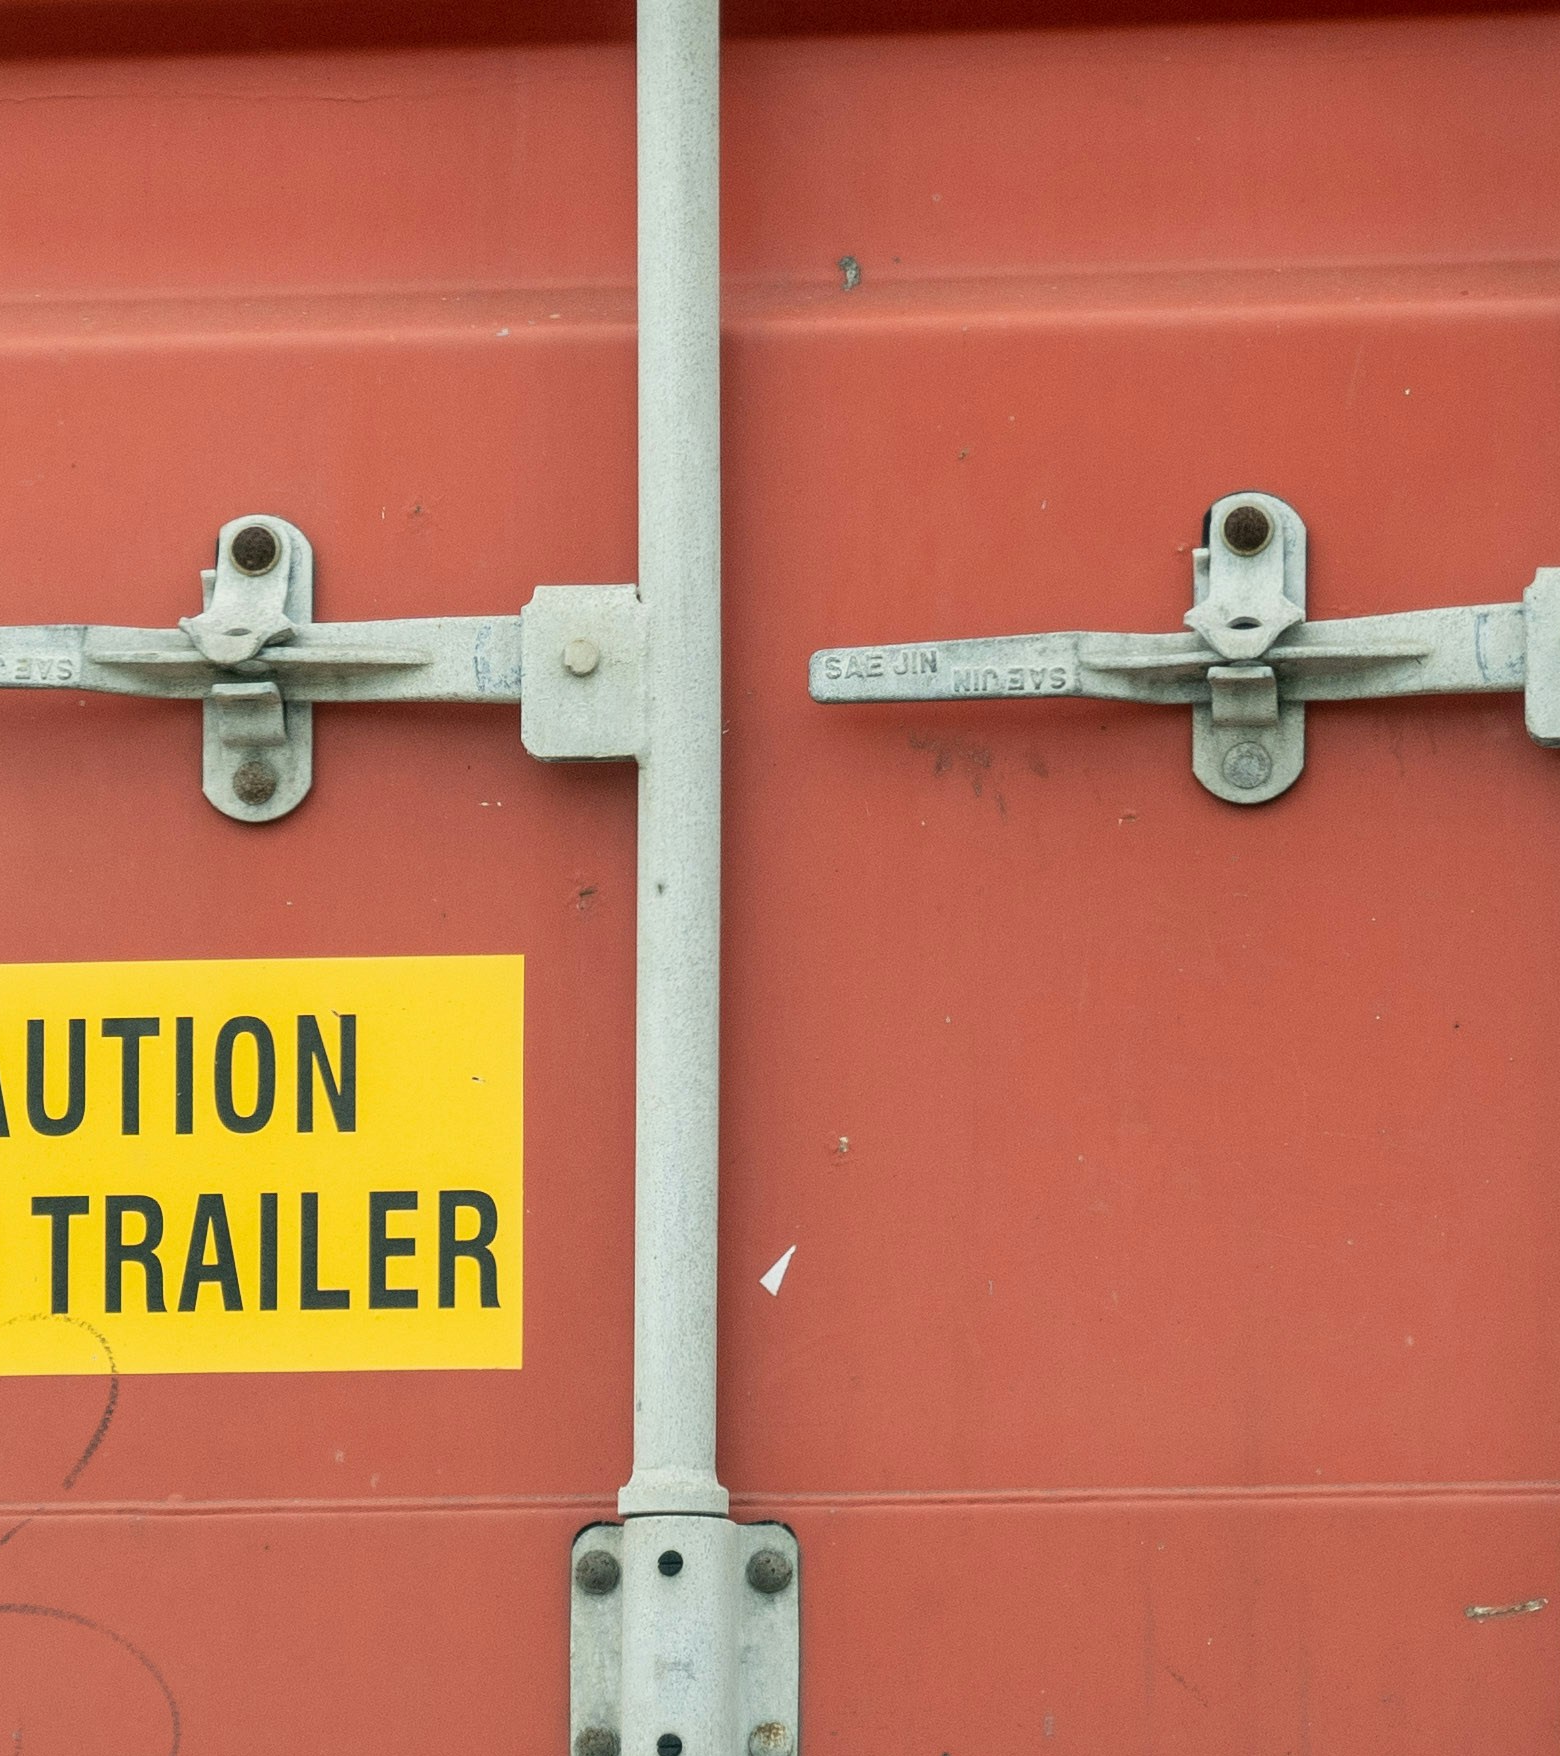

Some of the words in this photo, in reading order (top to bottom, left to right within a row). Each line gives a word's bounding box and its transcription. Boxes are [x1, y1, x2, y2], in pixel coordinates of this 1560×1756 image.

[824, 653, 884, 680] SAE
[893, 650, 938, 675] JIN
[30, 1189, 502, 1315] TRAILER
